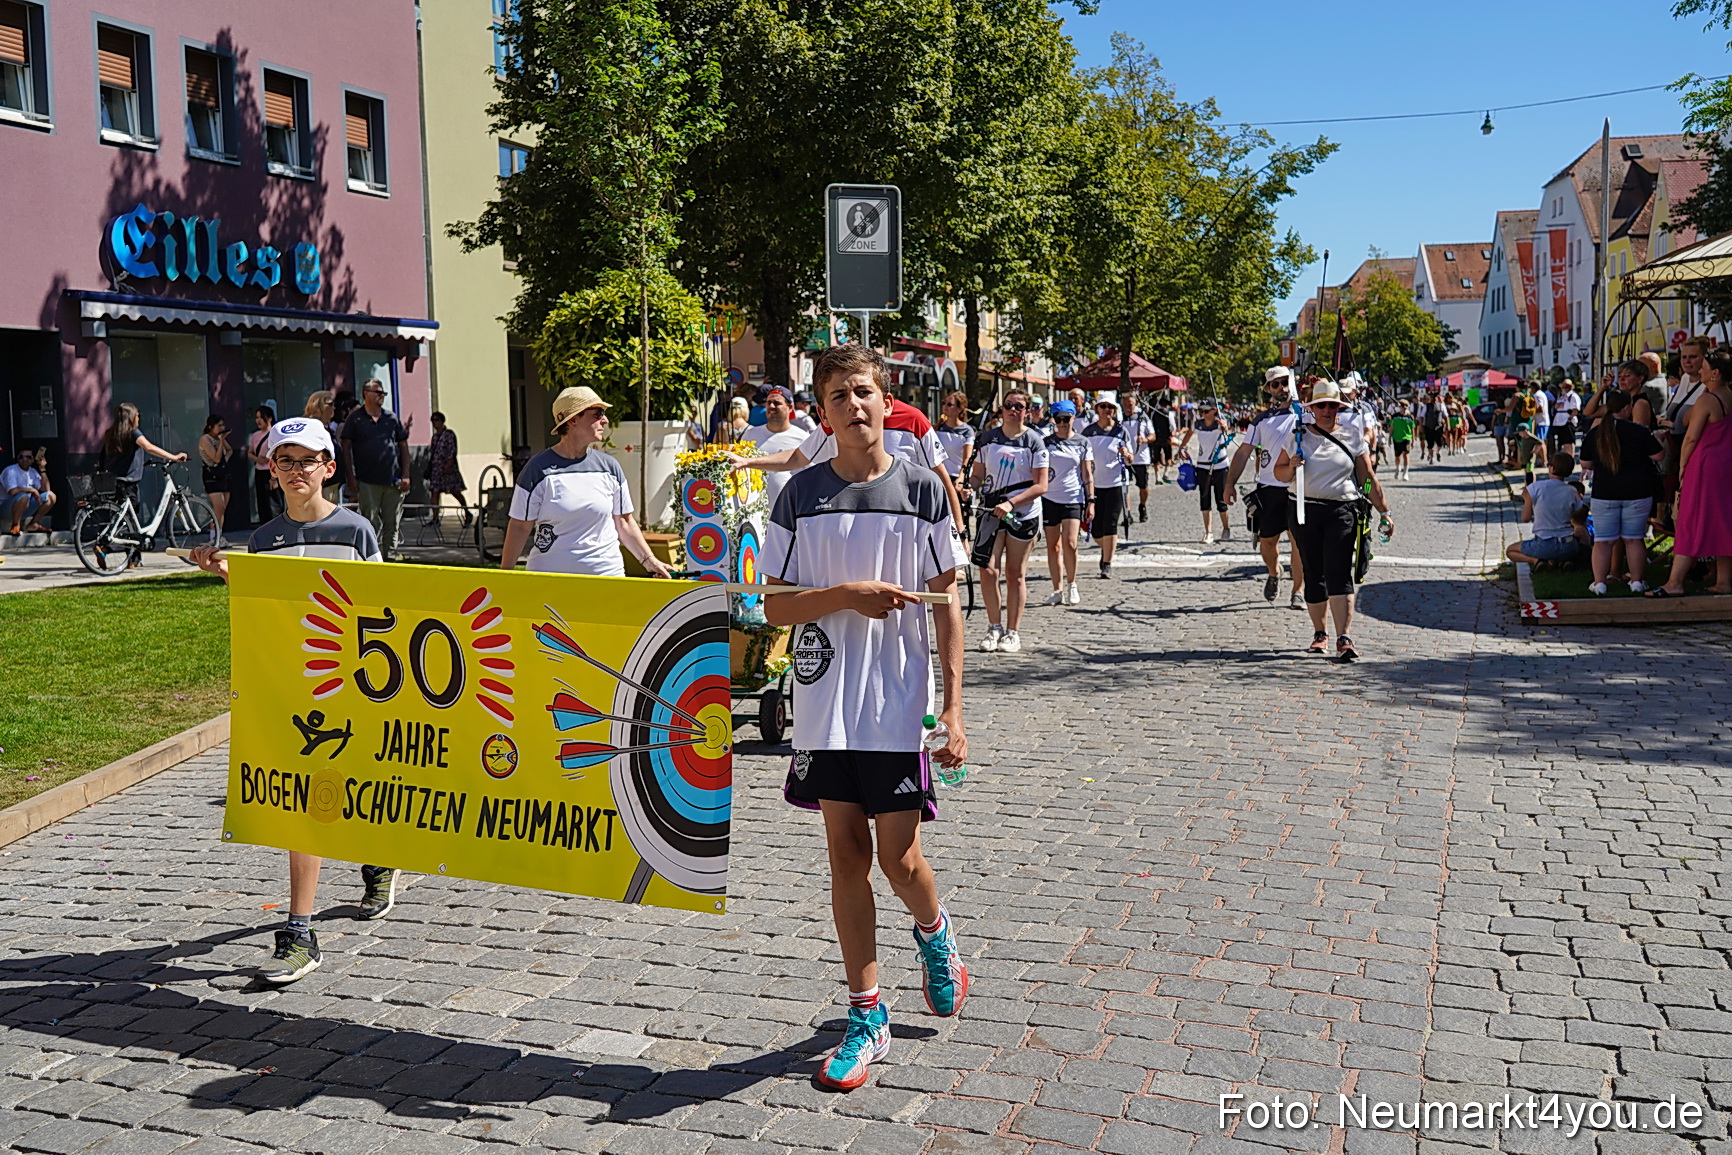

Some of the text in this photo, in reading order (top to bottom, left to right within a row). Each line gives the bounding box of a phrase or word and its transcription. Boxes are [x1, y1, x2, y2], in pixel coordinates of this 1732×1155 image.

[109, 203, 281, 290] Eilles
[851, 240, 877, 250] ZONE
[1551, 257, 1566, 299] SALE
[354, 607, 466, 709] 50
[374, 719, 450, 770] JAHRE
[241, 763, 618, 853] BOGEN SCHÜTZEN NEUMARKT
